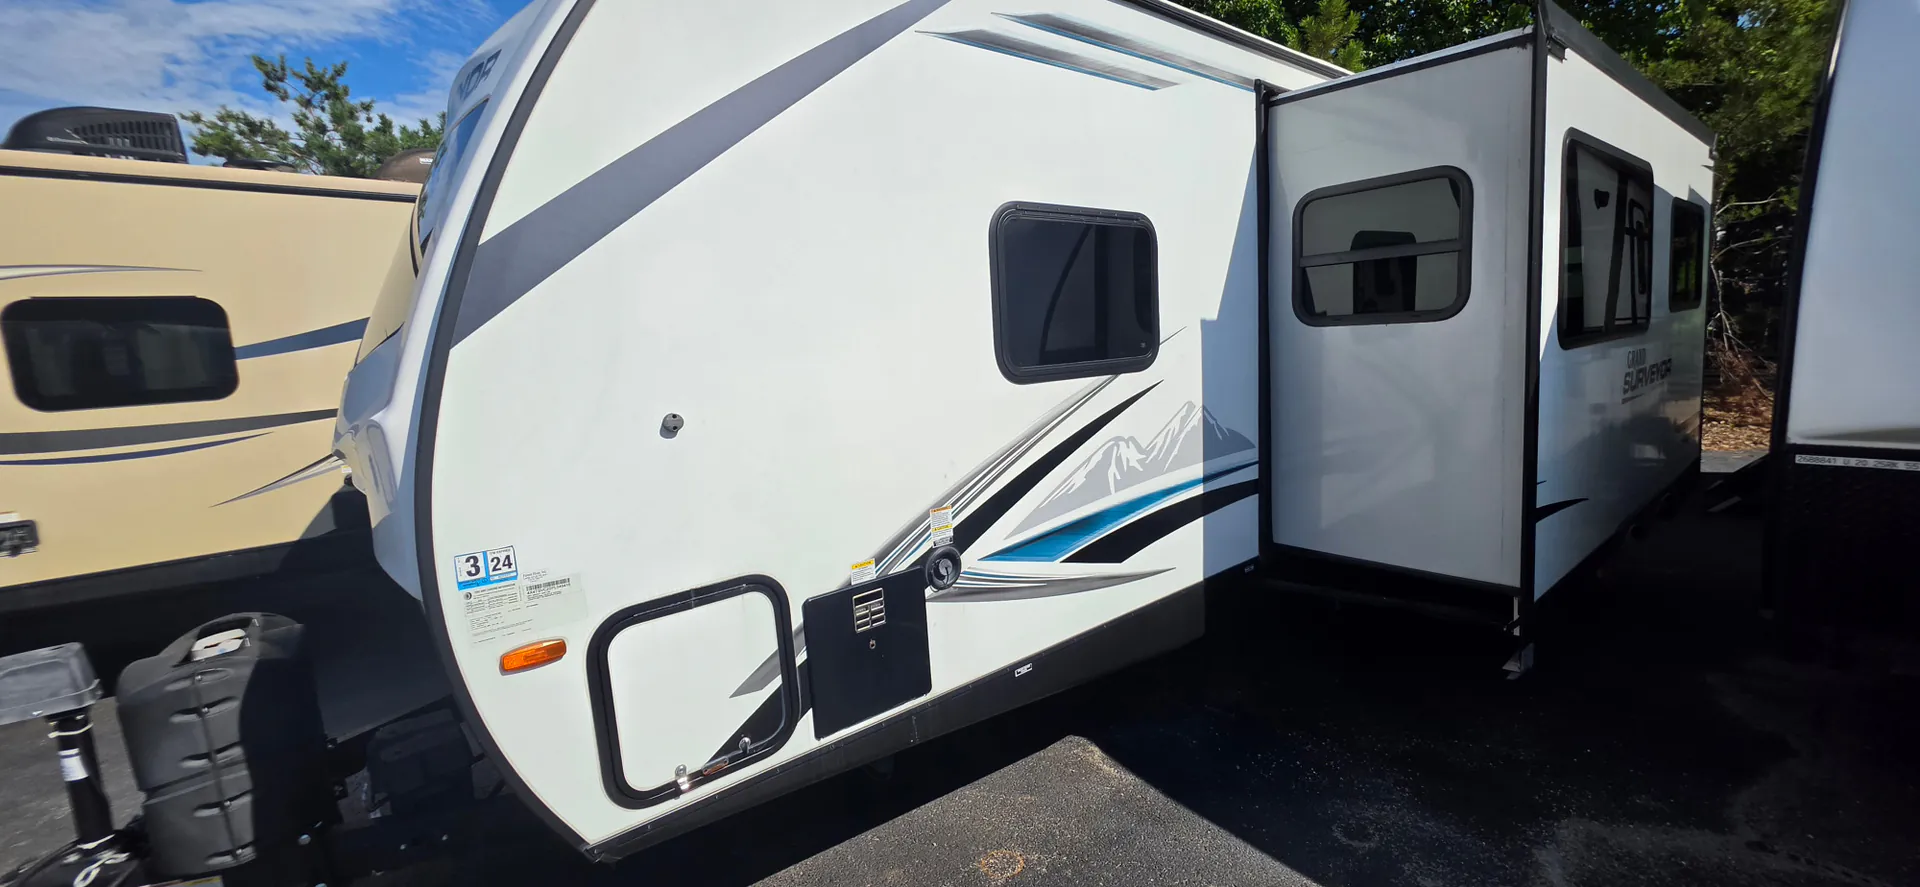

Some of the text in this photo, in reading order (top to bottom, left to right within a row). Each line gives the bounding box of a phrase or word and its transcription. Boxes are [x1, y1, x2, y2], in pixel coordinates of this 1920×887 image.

[1623, 357, 1672, 395] SURVEYOR
[465, 555, 481, 577] 3
[490, 554, 513, 572] 24
